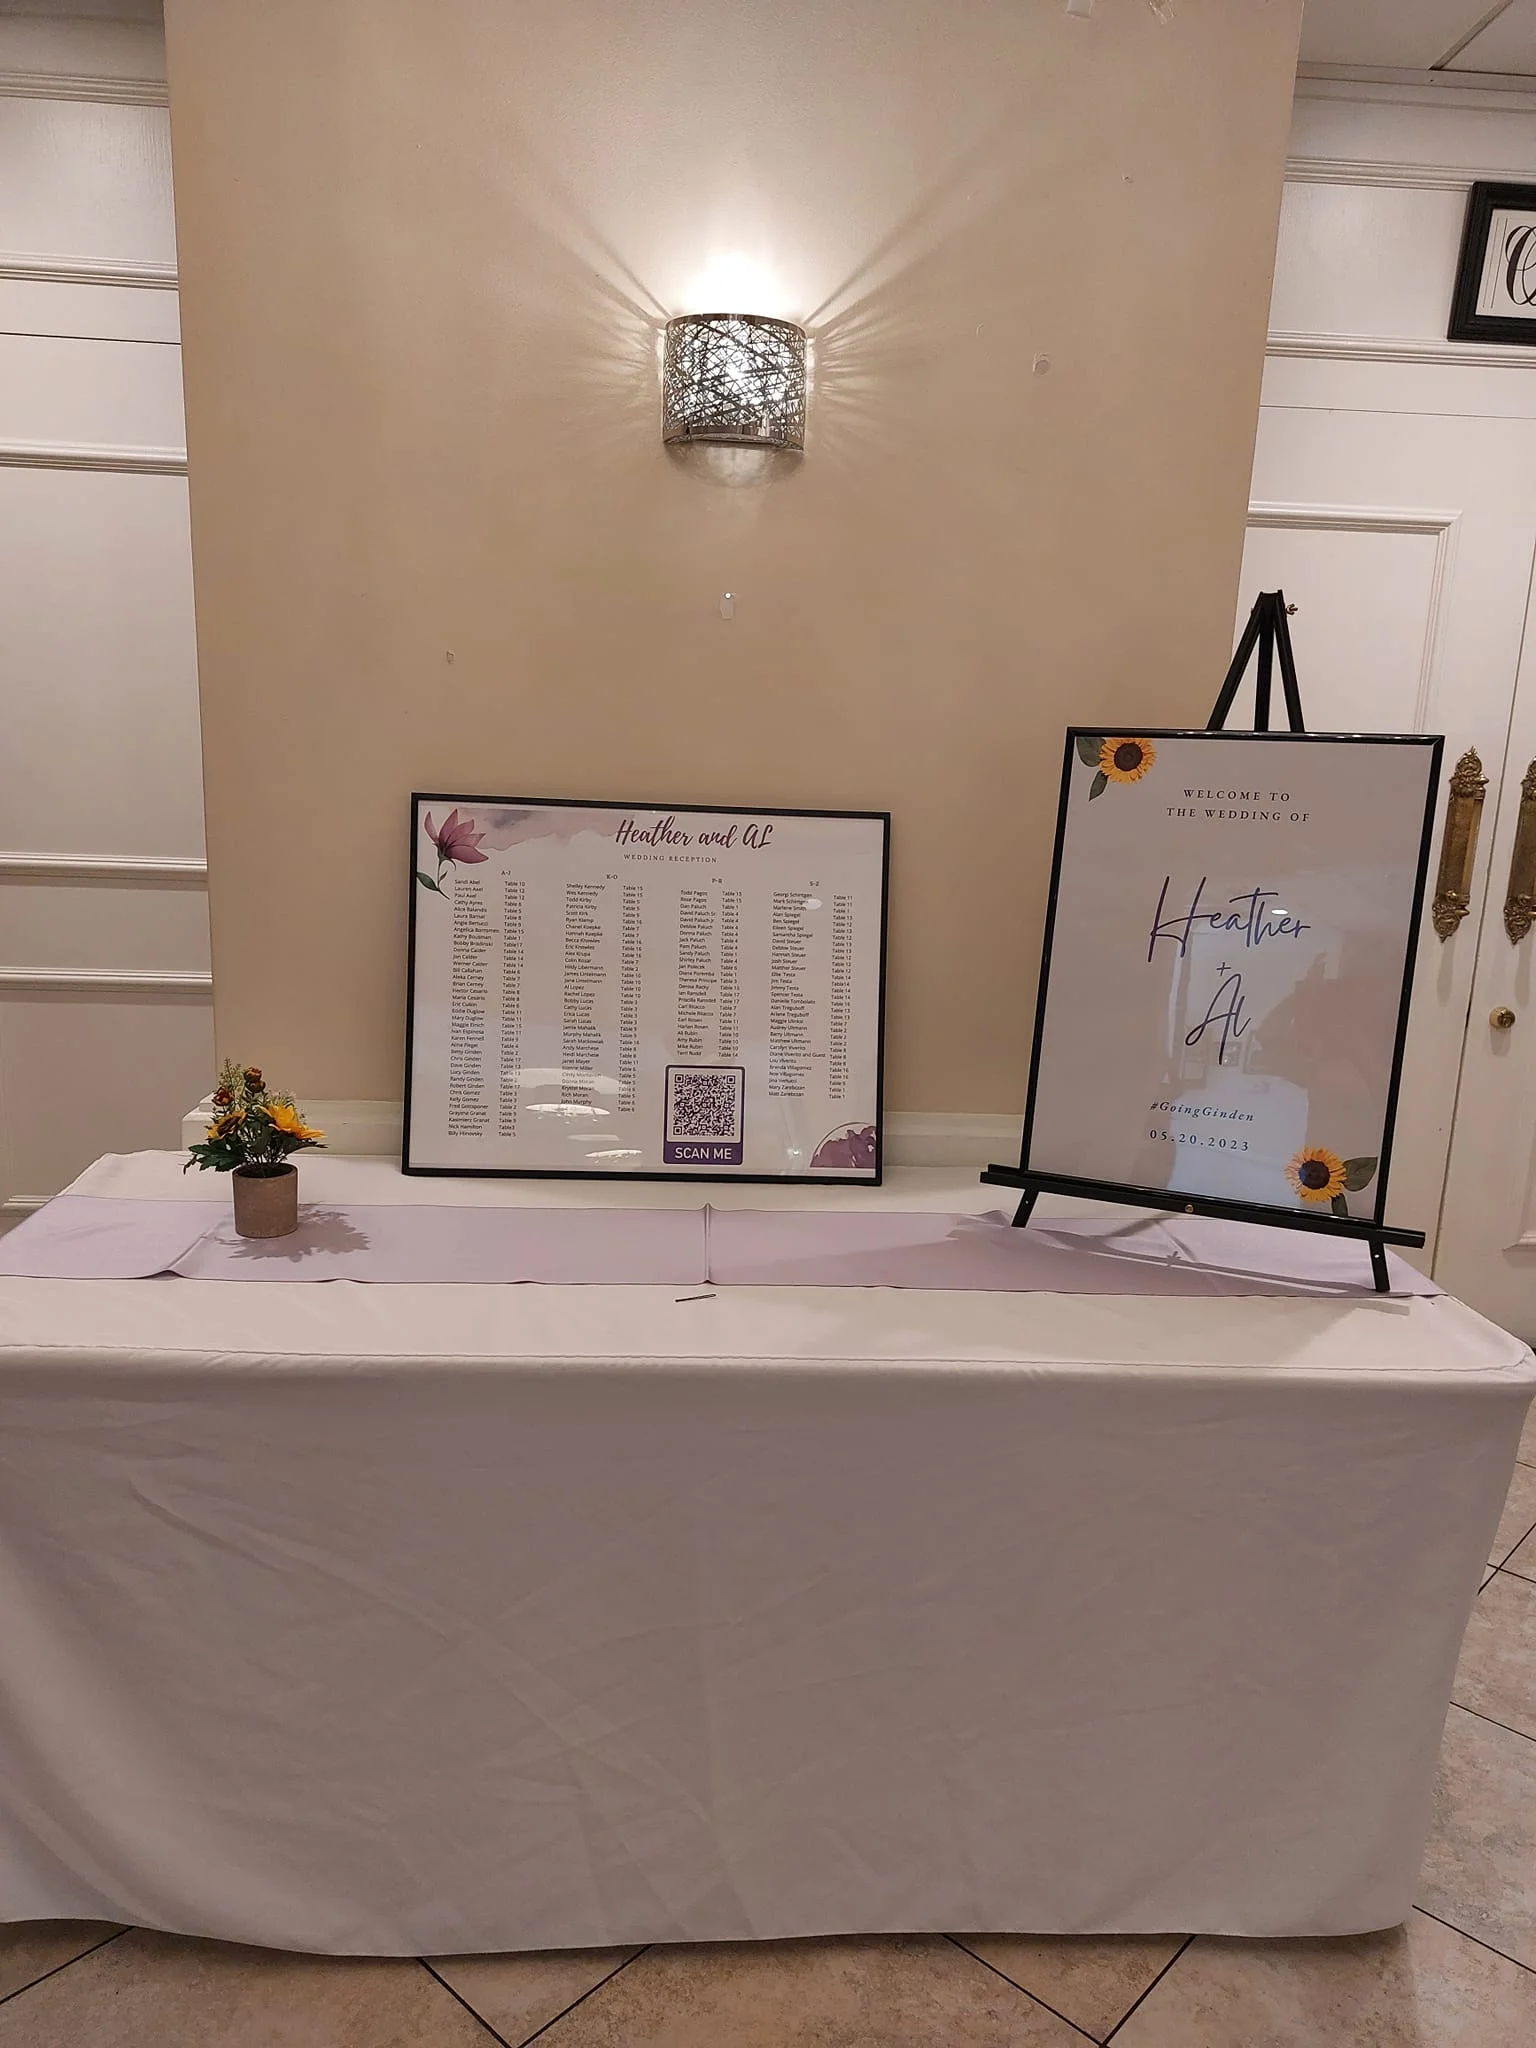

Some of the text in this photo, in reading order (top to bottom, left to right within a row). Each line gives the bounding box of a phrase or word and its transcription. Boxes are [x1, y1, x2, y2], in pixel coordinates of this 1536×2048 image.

[1182, 788, 1292, 802] WELCOME TO
[1166, 807, 1311, 823] THE WEDDING OF
[615, 815, 694, 847] Heather
[698, 824, 738, 849] and
[623, 853, 717, 864] WEDDING RECEPTION
[1147, 875, 1312, 963] Heather
[1184, 973, 1252, 1066] Al
[1149, 1101, 1256, 1123] #GoingGinden
[1149, 1129, 1250, 1152] 05.20.2023
[674, 1146, 733, 1161] SCAN ME
